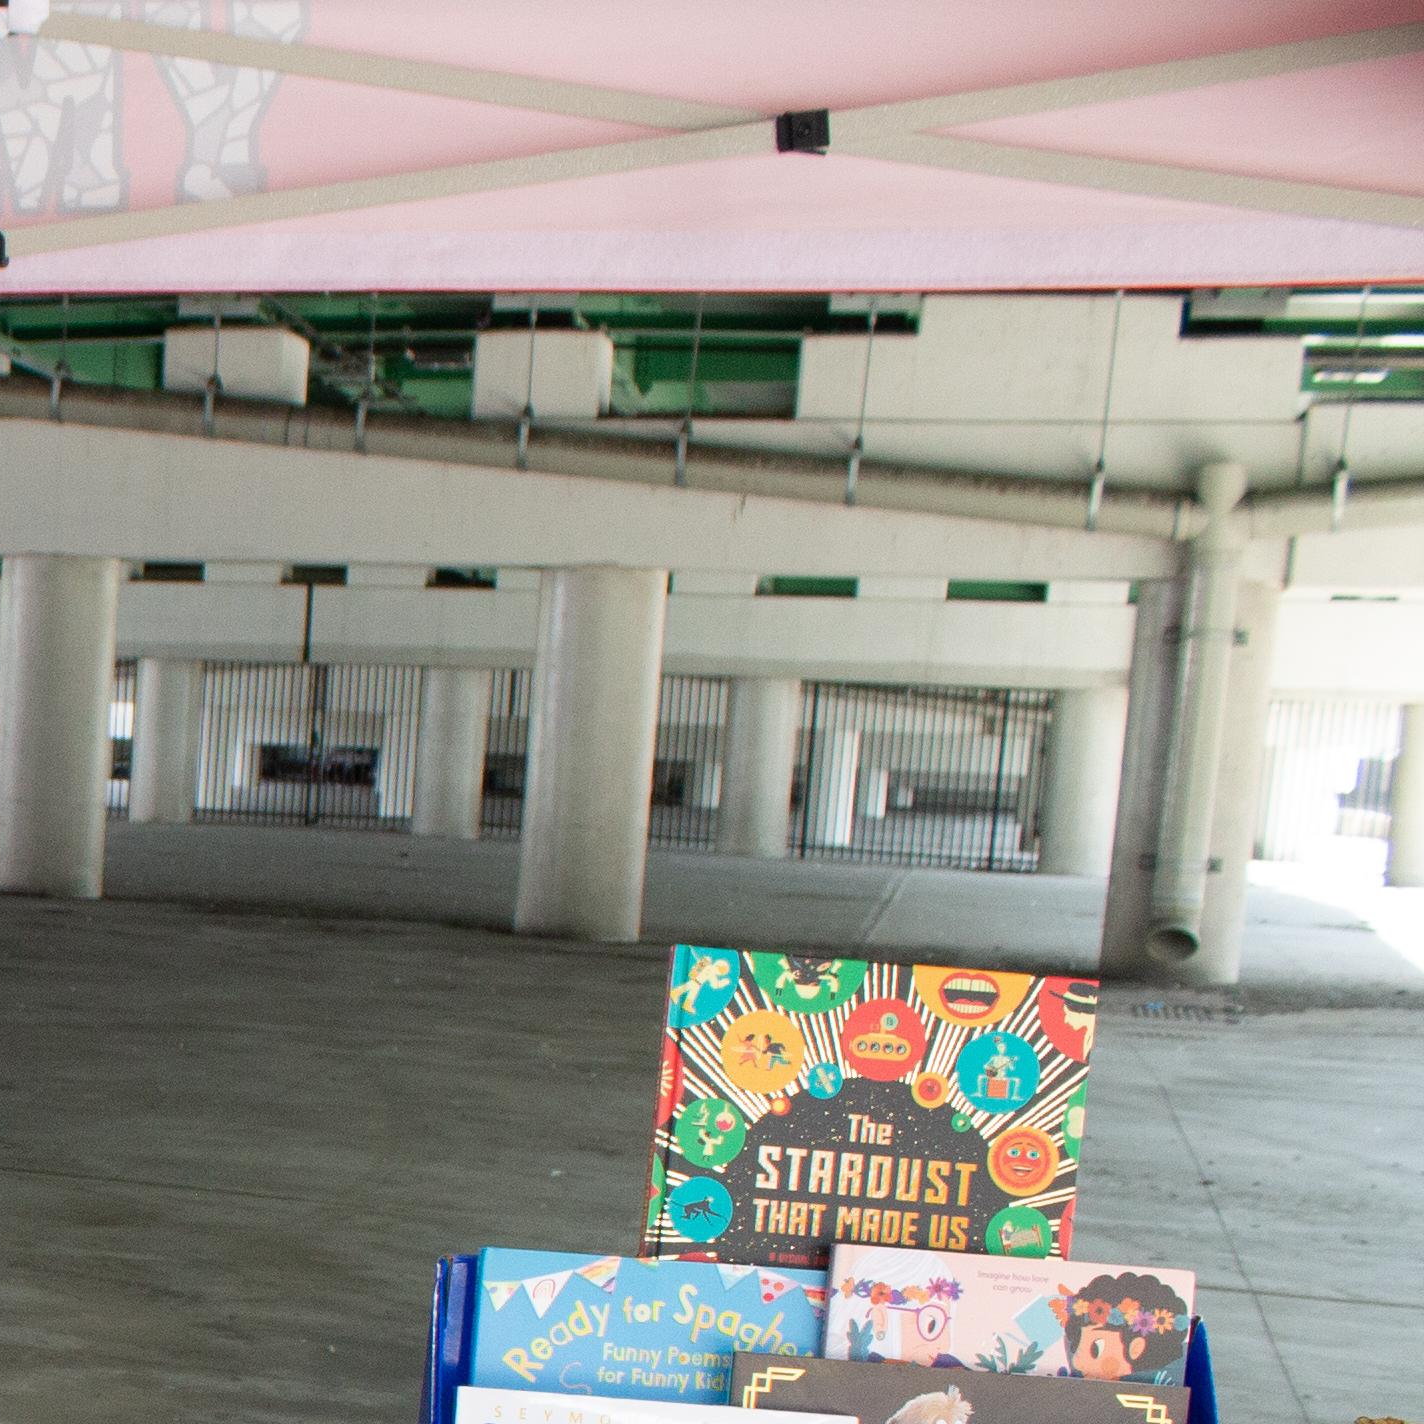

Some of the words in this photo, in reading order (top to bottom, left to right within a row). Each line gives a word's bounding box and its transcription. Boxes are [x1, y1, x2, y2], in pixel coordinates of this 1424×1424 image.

[848, 1113, 893, 1146] The
[755, 1145, 978, 1206] STARDUST
[752, 1198, 828, 1237] THAT
[836, 1206, 918, 1247] MADE
[929, 1215, 970, 1251] US
[1009, 1285, 1033, 1295] grow
[1012, 1273, 1030, 1283] how
[1030, 1274, 1050, 1284] love
[502, 1300, 610, 1383] Ready
[623, 1296, 665, 1324] for
[603, 1342, 662, 1368] Funny
[598, 1367, 624, 1385] for
[631, 1368, 690, 1391] Funny
